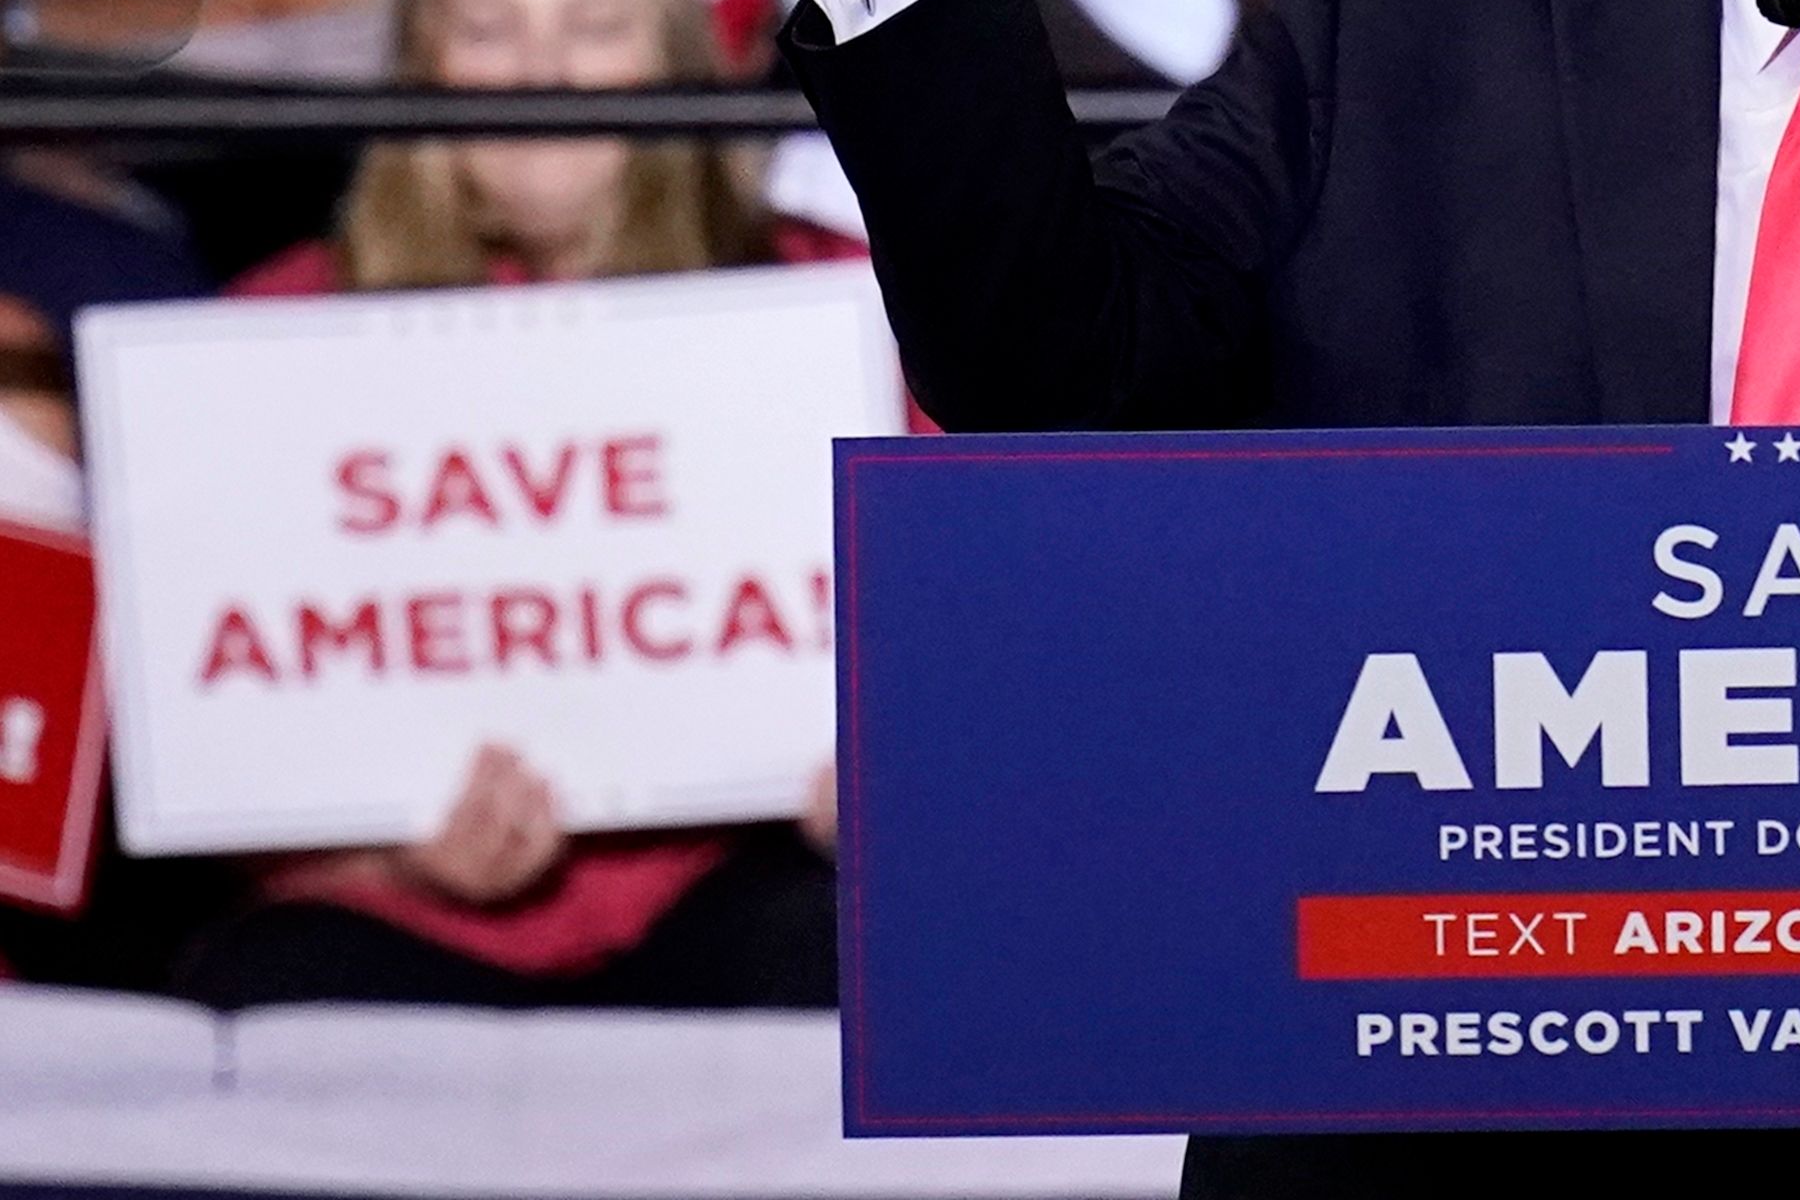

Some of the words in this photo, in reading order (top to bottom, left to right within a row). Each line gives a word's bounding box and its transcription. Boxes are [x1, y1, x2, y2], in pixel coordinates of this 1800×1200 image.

[334, 434, 670, 536] SAVE
[199, 568, 832, 688] AMERICA!
[1440, 820, 1734, 860] PRESIDENT
[1424, 912, 1586, 956] TEXT
[1357, 1011, 1703, 1056] PRESCOTT
